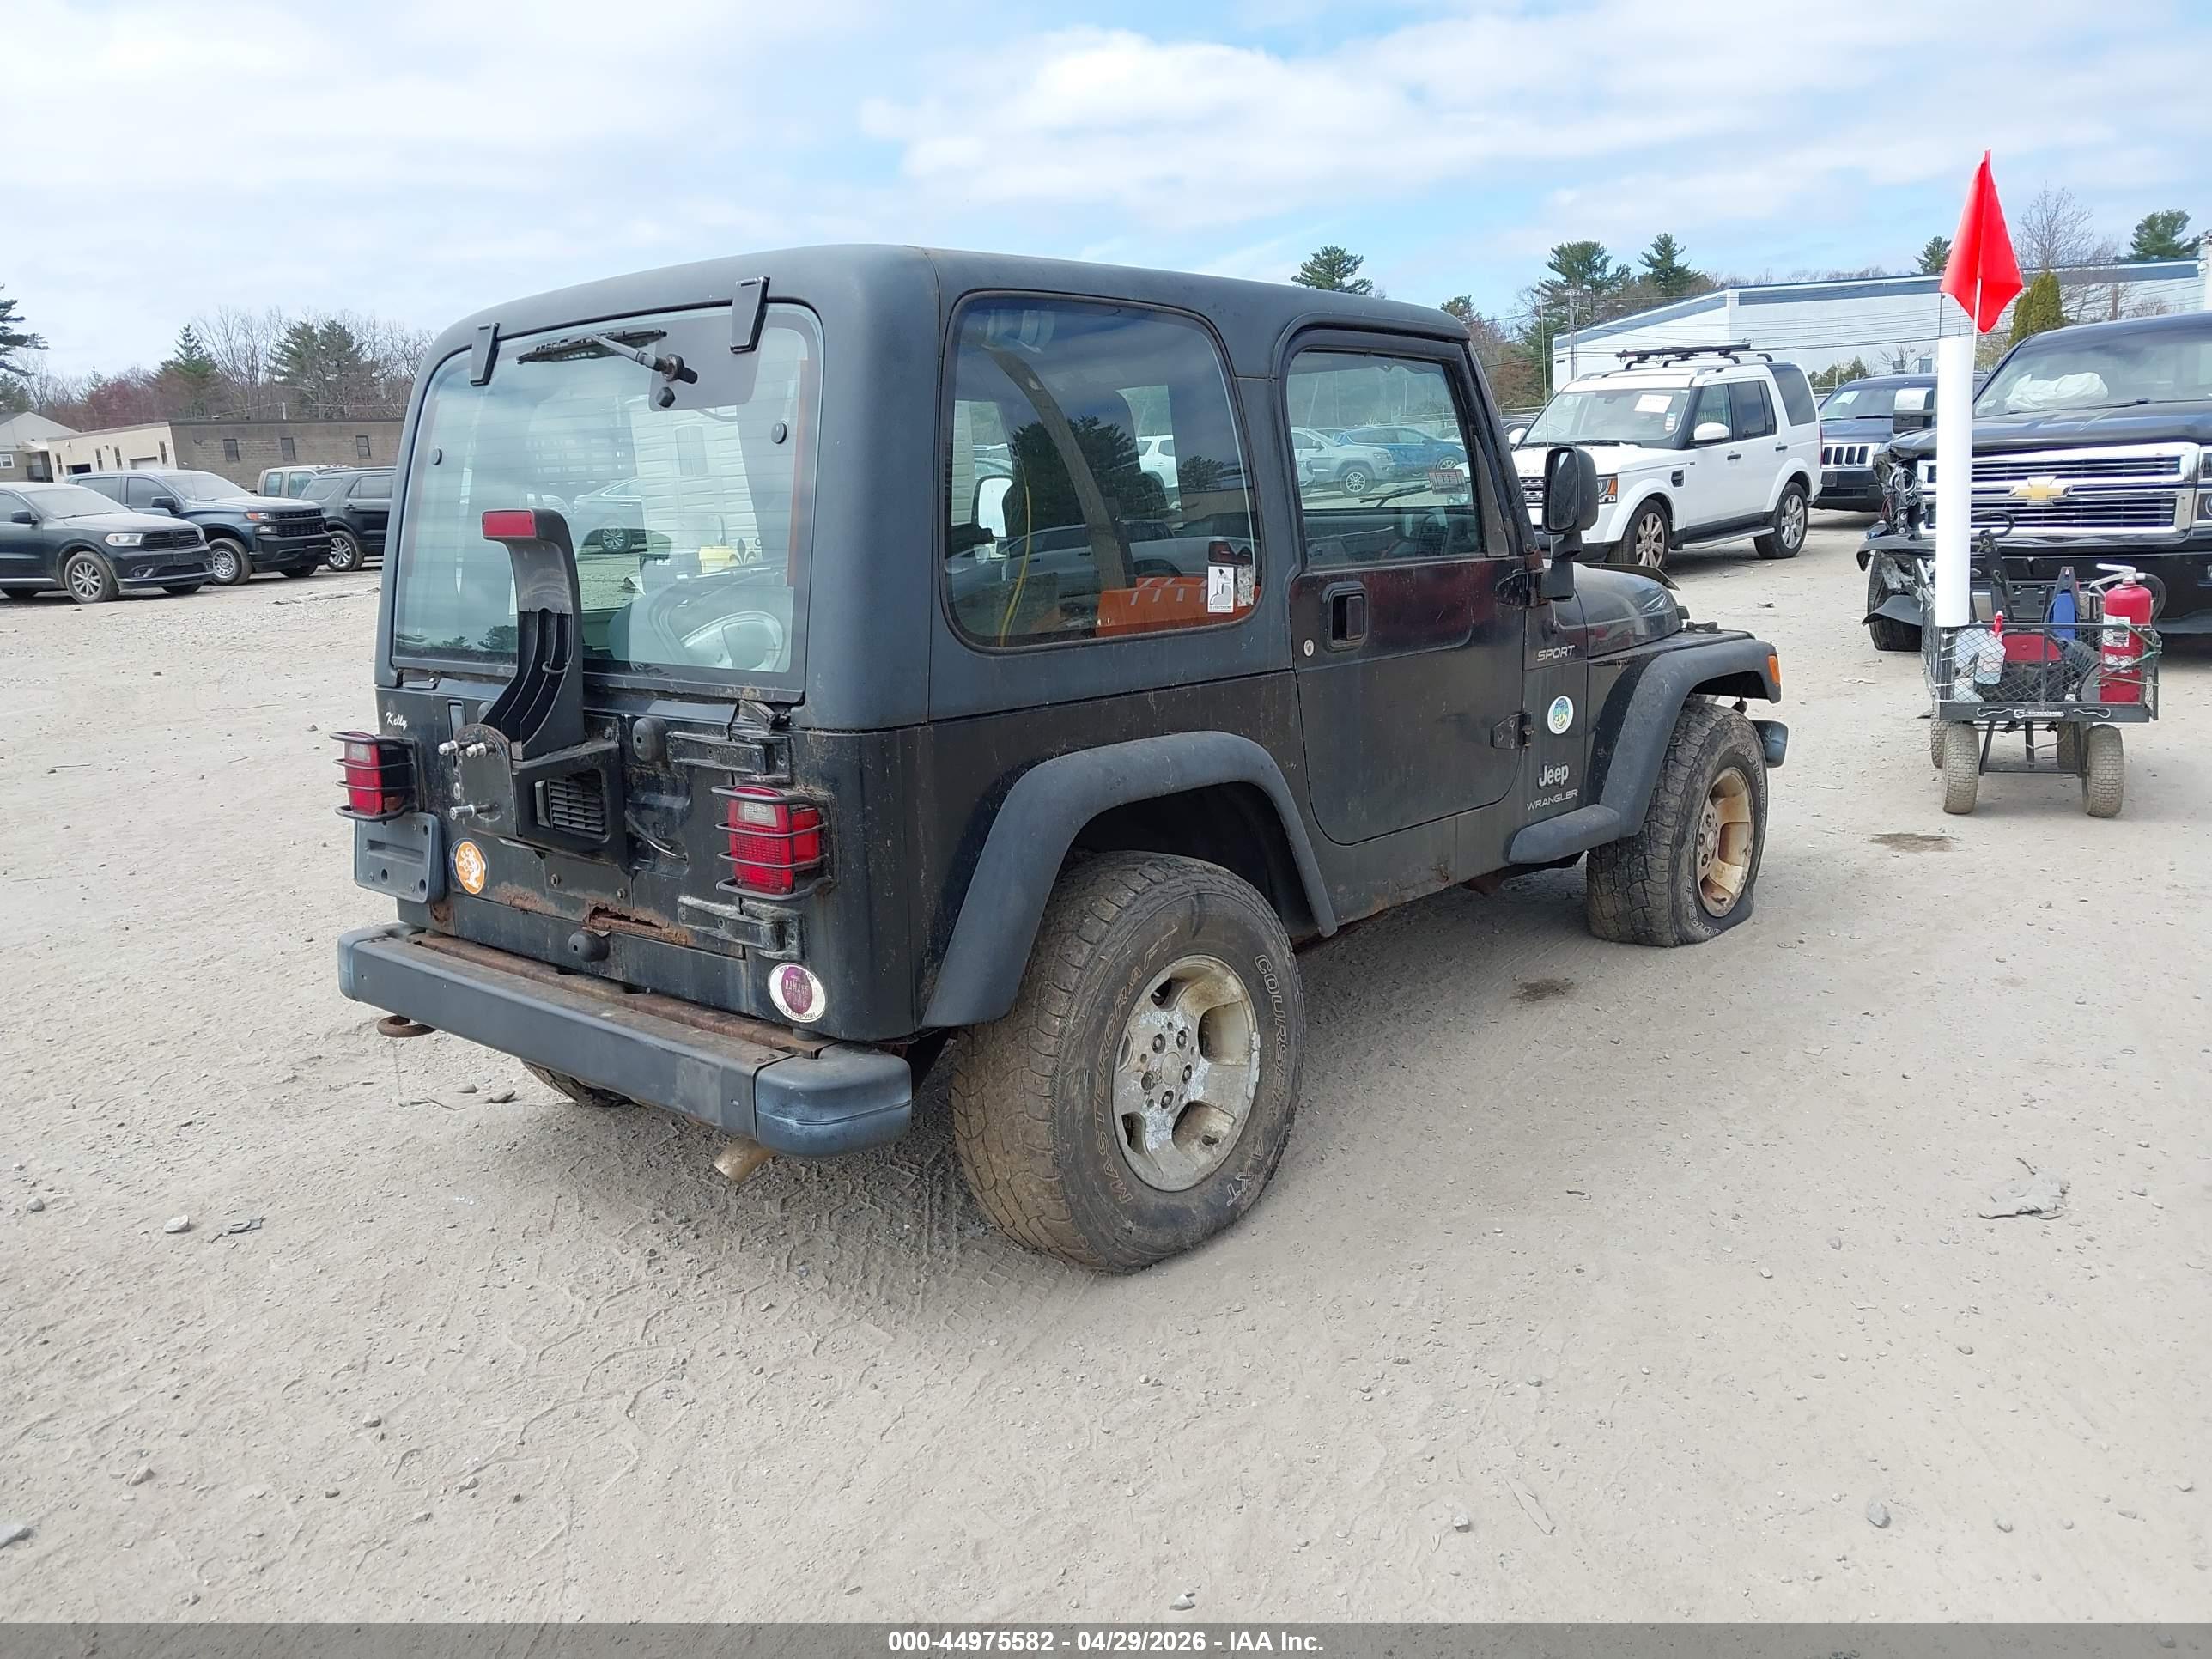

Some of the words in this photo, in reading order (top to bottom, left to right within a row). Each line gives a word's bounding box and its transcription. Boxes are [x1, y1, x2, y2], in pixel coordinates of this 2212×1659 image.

[1537, 645, 1576, 662] SPORT
[386, 712, 408, 732] Kelly
[1538, 764, 1570, 787] Jeep
[1526, 789, 1579, 811] WRANGLER
[1254, 953, 1288, 1121] COURSER
[1093, 927, 1179, 1203] MASTERCRAFT
